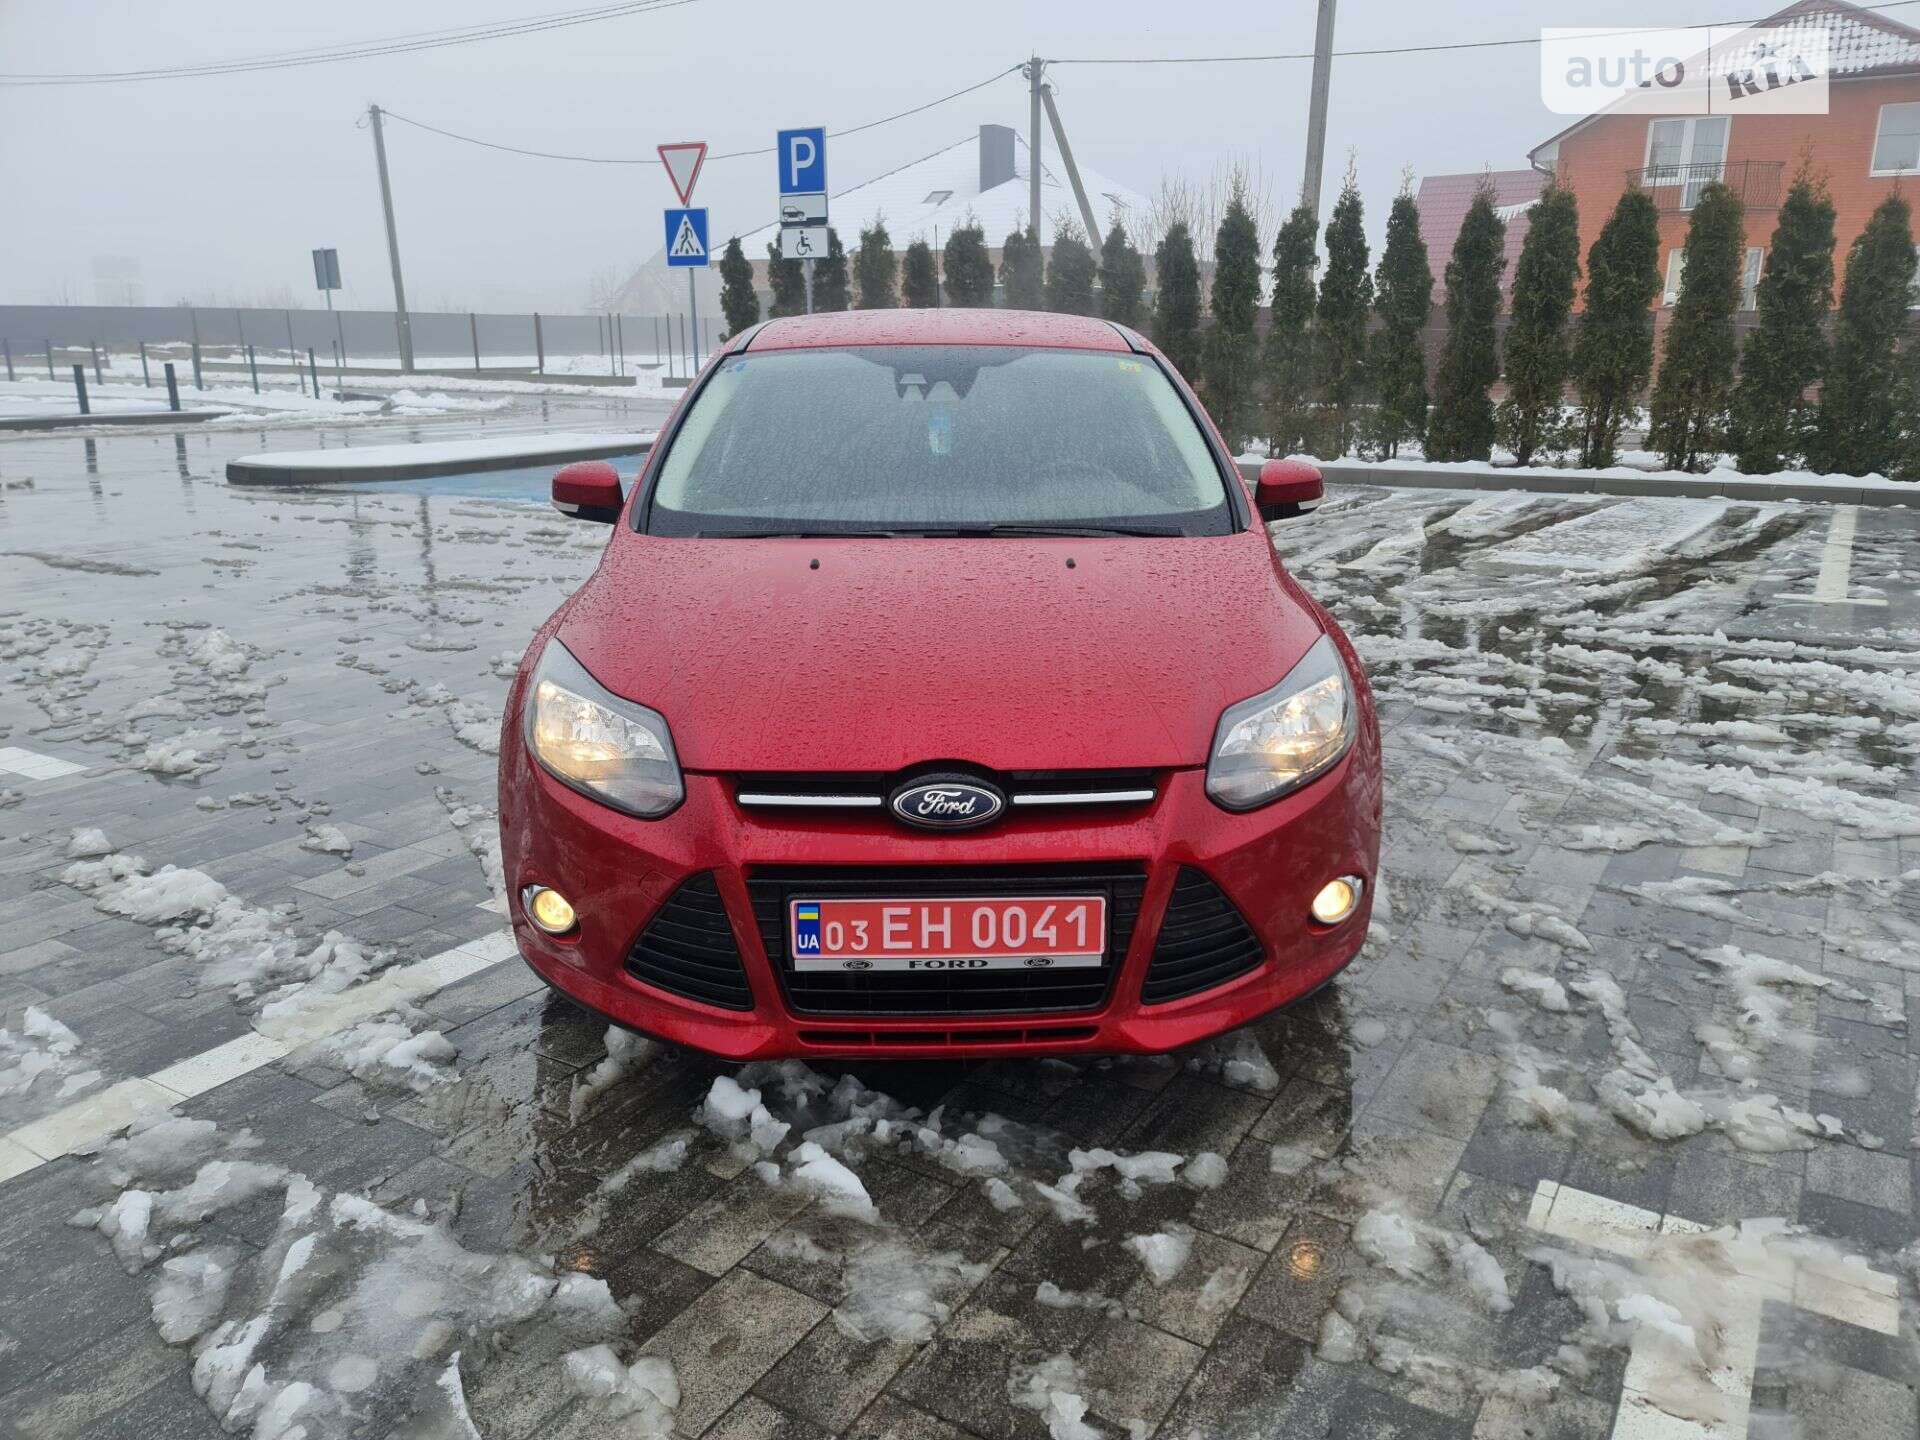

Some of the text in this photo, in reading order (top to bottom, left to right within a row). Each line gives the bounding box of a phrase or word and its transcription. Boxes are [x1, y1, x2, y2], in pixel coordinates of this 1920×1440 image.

[790, 136, 816, 187] P
[918, 790, 977, 815] Ford
[825, 905, 1087, 951] 03 EH 0041
[798, 933, 820, 949] UA
[908, 958, 989, 969] FORD
